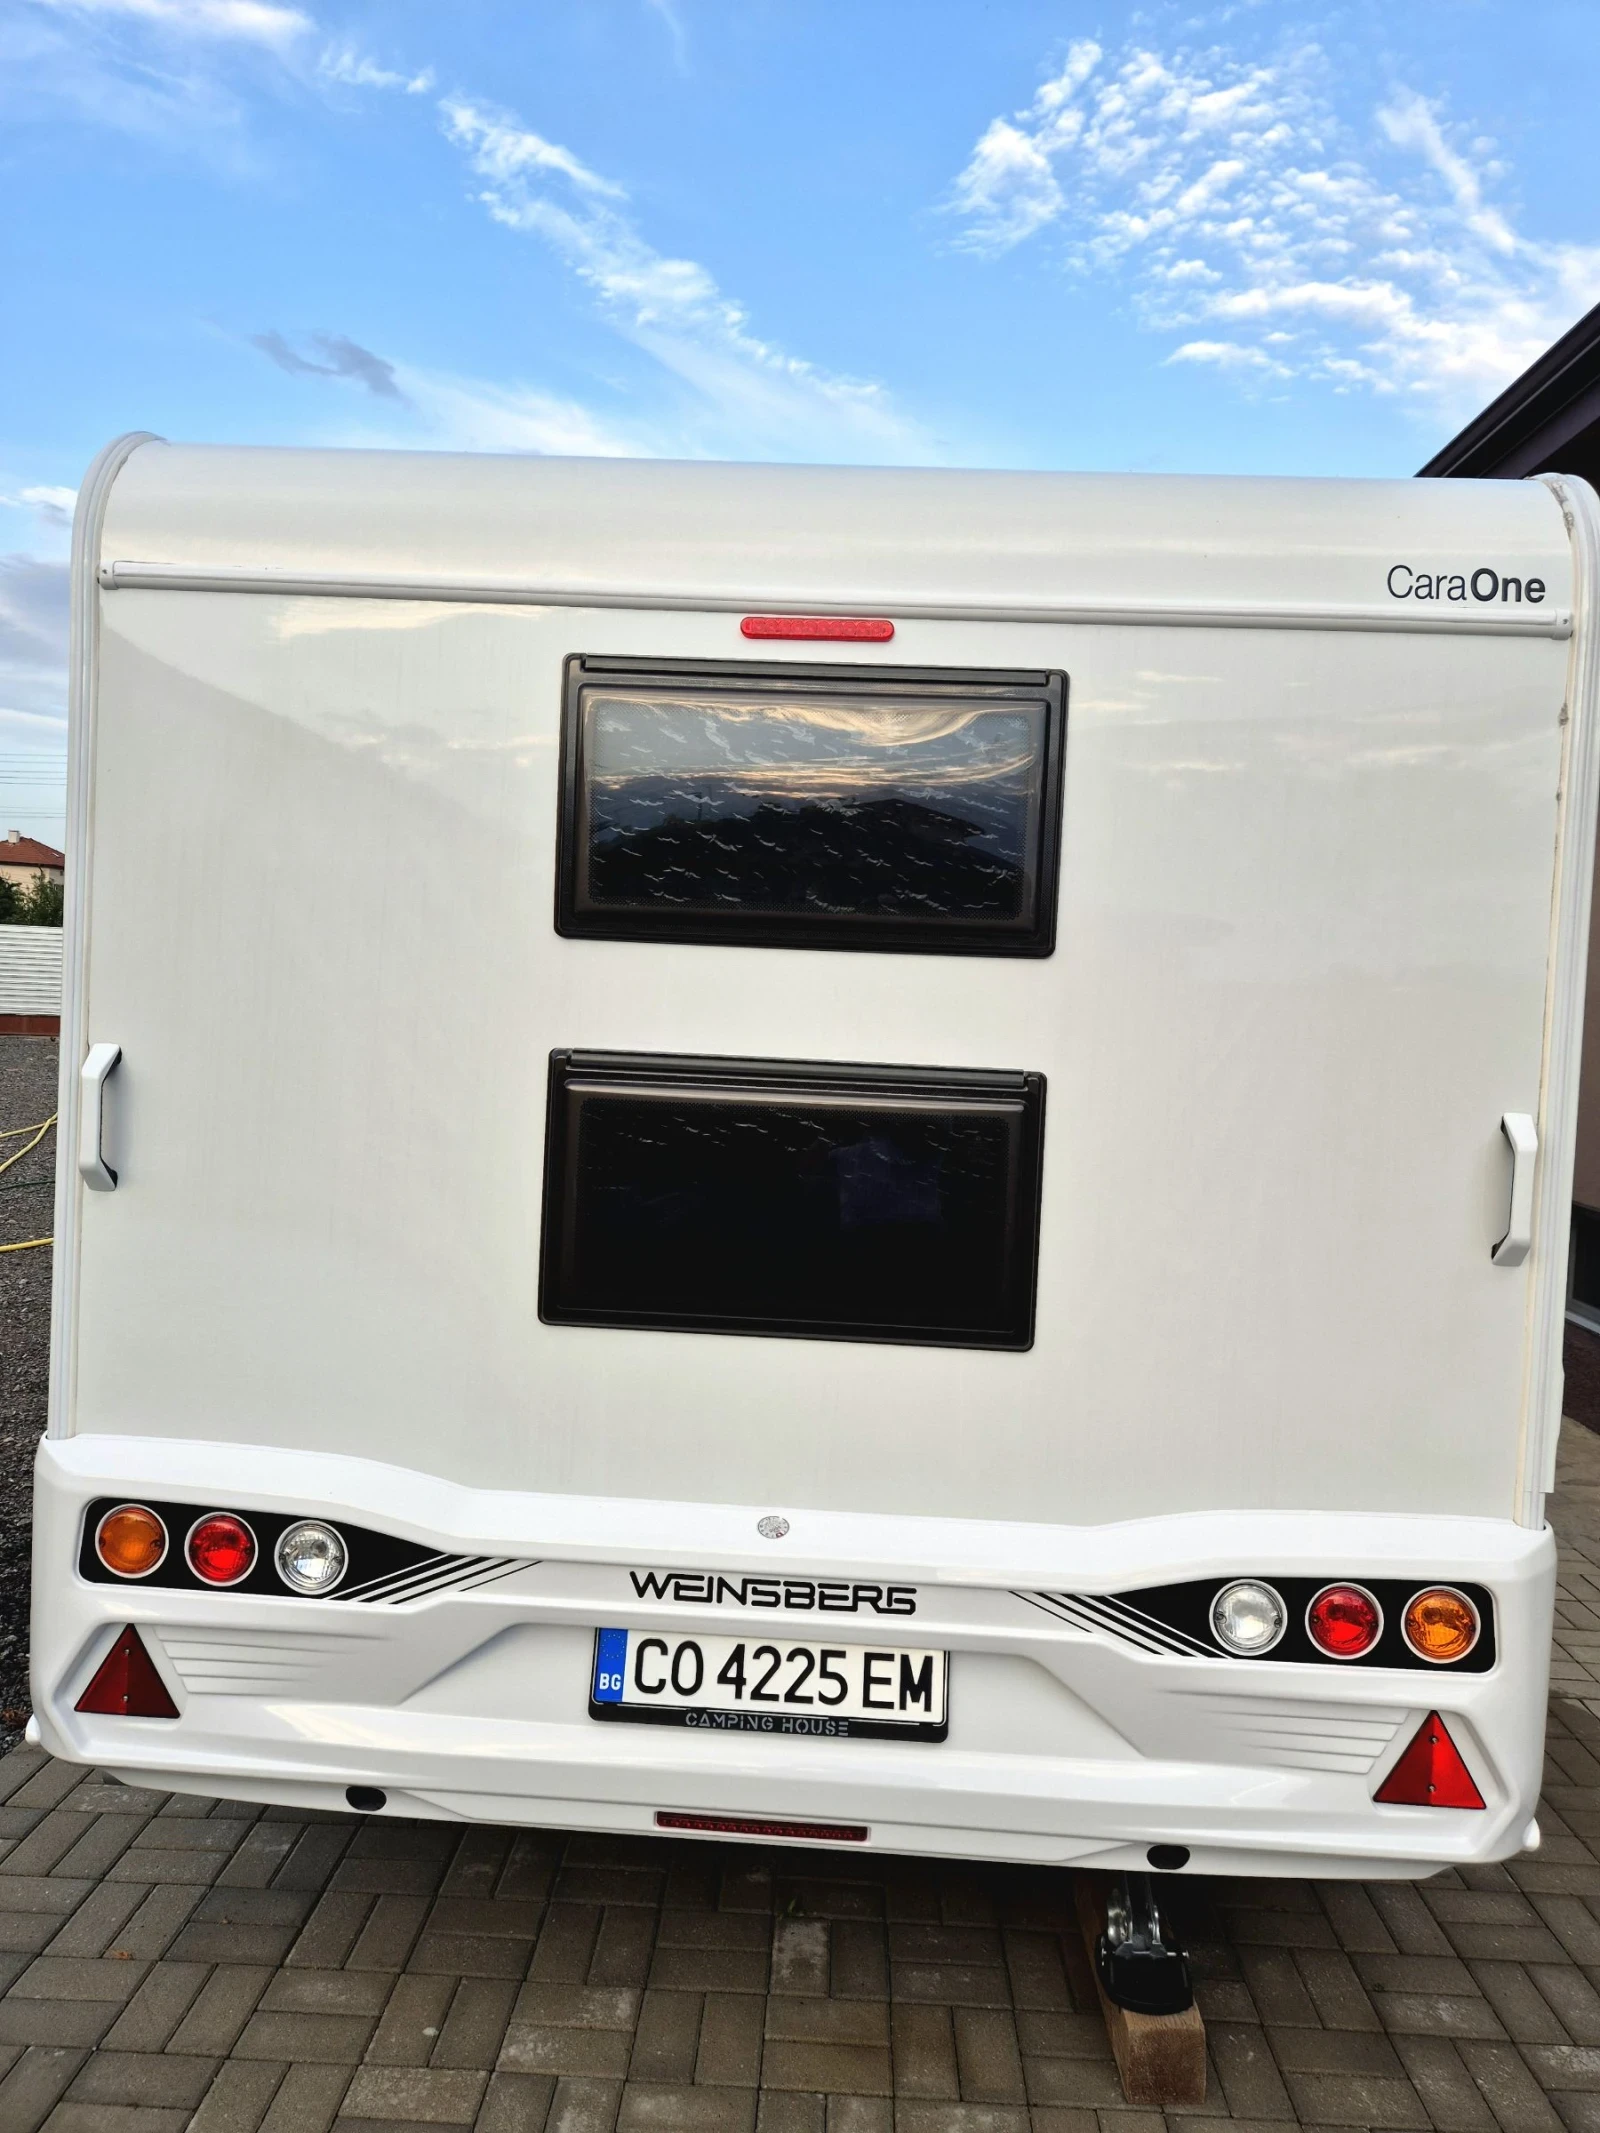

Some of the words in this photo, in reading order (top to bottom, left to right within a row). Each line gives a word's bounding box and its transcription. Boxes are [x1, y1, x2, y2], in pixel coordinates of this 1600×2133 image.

[1387, 564, 1546, 603] CaraOne
[629, 1571, 917, 1615] WEINSBERG
[599, 1672, 622, 1691] BG
[717, 1643, 849, 1706] 4225
[862, 1652, 933, 1712] EM
[685, 1711, 773, 1731] CAMPING
[781, 1718, 849, 1737] HOUSE
